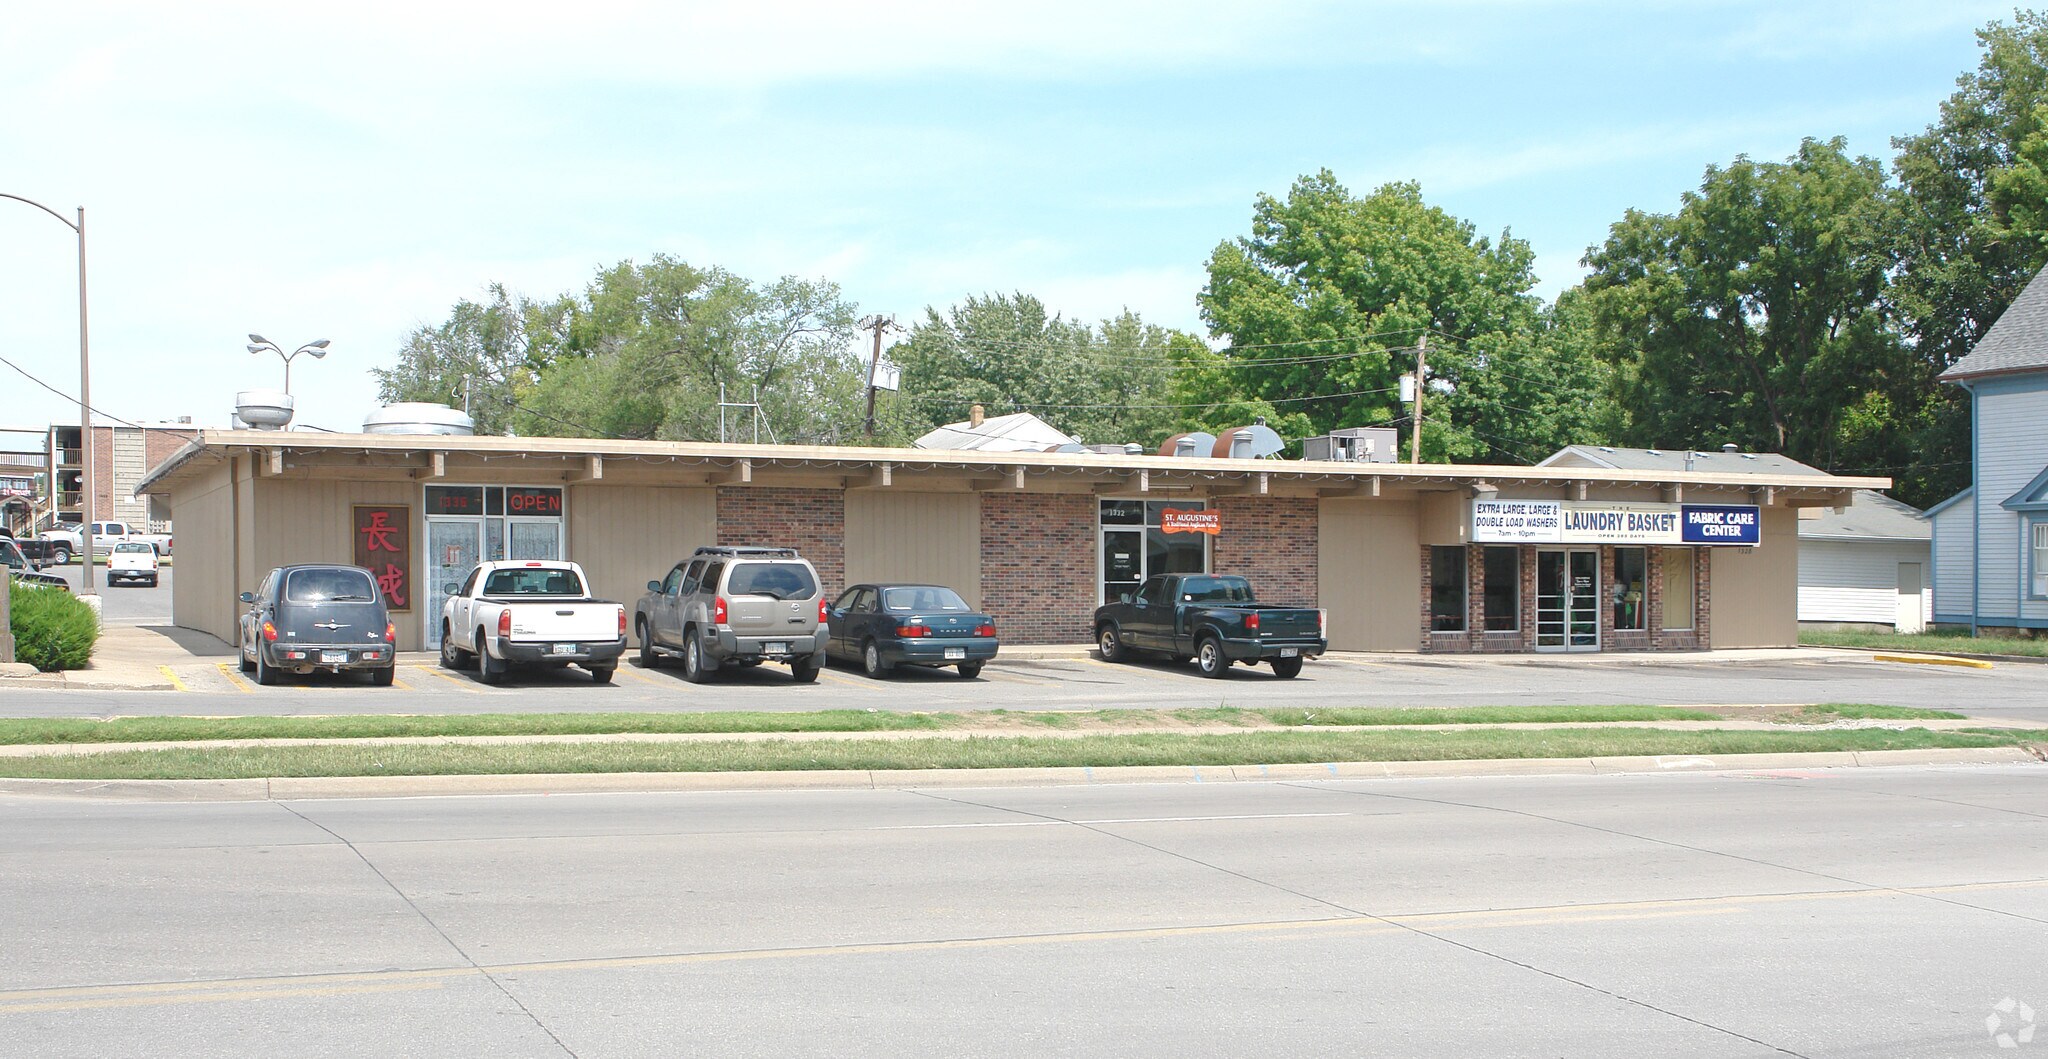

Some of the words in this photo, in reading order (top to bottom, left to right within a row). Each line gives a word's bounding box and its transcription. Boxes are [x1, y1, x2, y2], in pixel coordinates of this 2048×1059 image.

[511, 494, 559, 511] OPEN
[1477, 504, 1501, 514] EXTRA
[1529, 505, 1551, 515] LARGE
[1553, 505, 1557, 515] &
[1177, 514, 1218, 522] AUGUSTINE'S
[1476, 517, 1504, 527] DOUBLE
[1506, 518, 1524, 527] LOAD
[1527, 518, 1558, 528] WASHERS
[1565, 512, 1624, 531] LAUNDRY
[1628, 513, 1676, 532] BASKET
[1689, 512, 1724, 524] FABRIC
[1727, 513, 1754, 525] CARE
[1518, 530, 1536, 538] 10pm
[1702, 524, 1741, 537] CENTER
